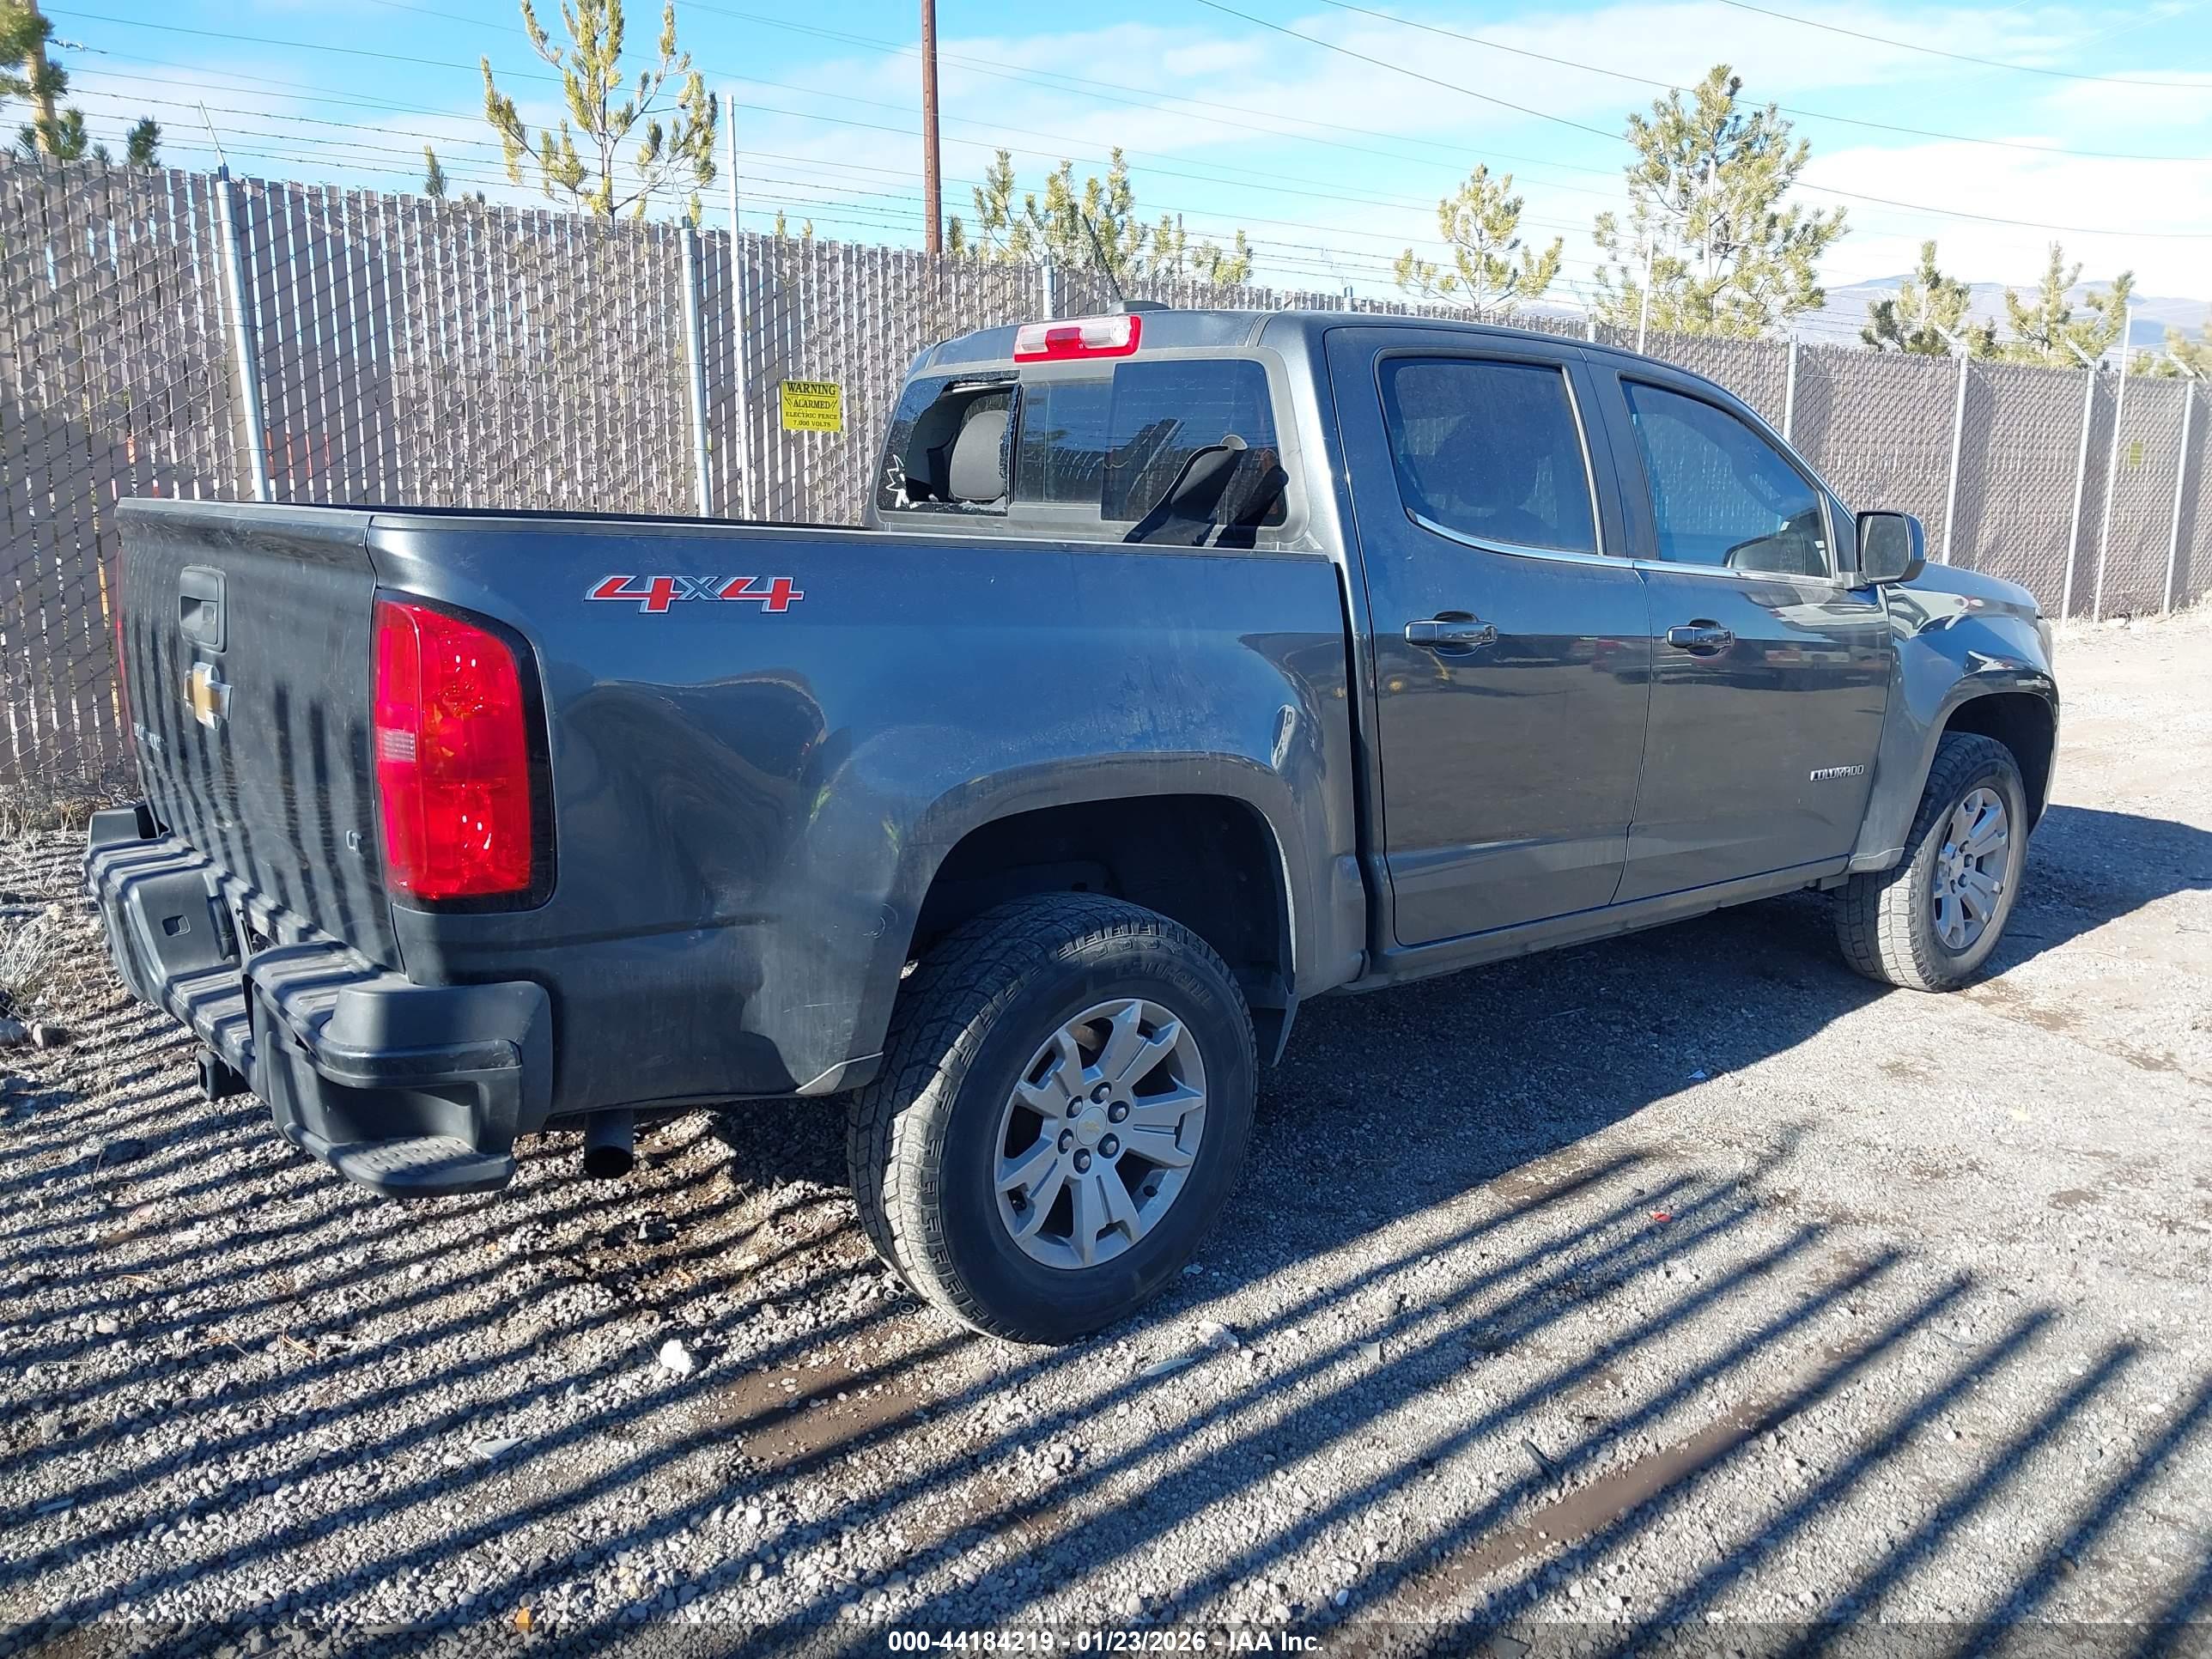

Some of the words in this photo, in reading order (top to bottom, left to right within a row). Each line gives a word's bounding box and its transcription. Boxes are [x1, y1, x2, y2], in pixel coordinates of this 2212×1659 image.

[787, 382, 836, 396] WARNING
[793, 399, 830, 410] ALARMED
[1809, 764, 1864, 781] COLORADO
